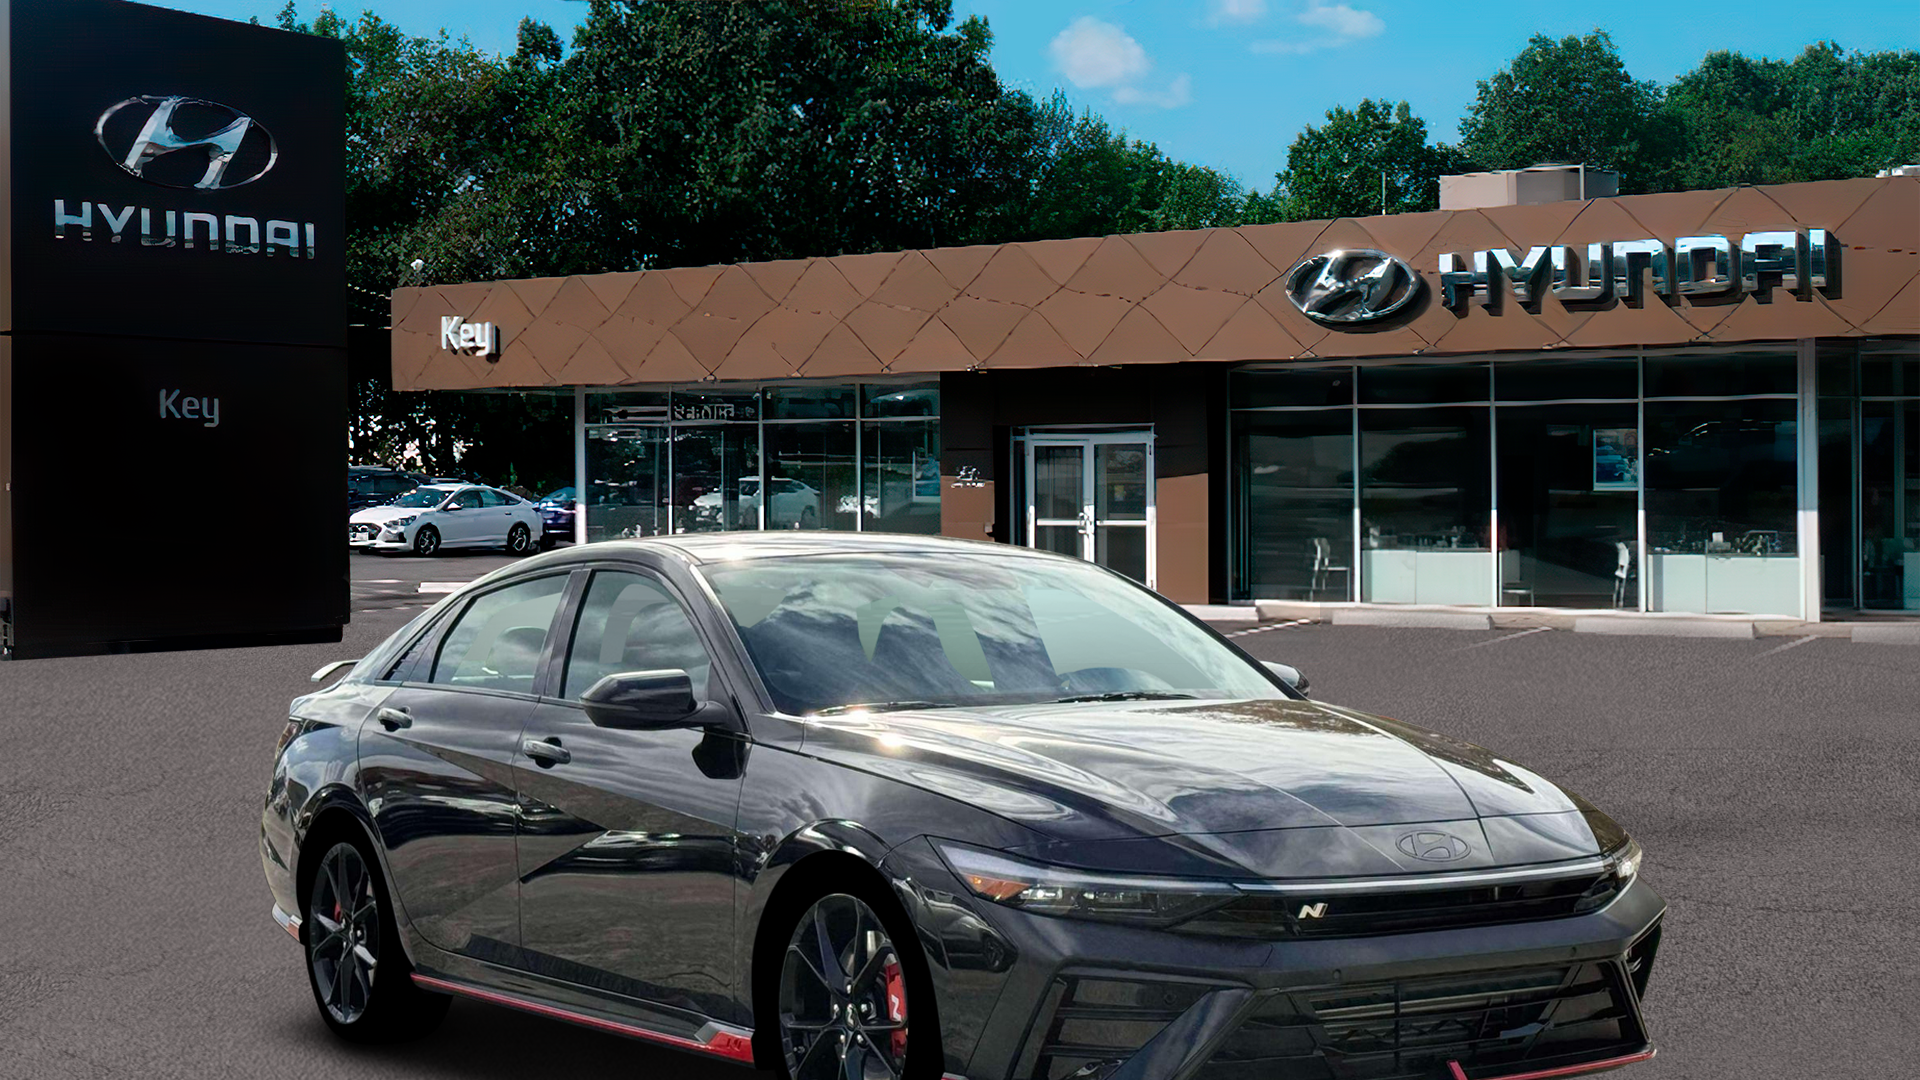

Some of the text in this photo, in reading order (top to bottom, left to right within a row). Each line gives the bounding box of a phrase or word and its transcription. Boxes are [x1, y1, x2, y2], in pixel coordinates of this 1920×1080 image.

[54, 199, 315, 260] HYUNDAI
[1438, 228, 1838, 312] HYUNDAI
[441, 315, 493, 357] Key
[159, 388, 220, 428] Key
[1298, 902, 1328, 919] N
